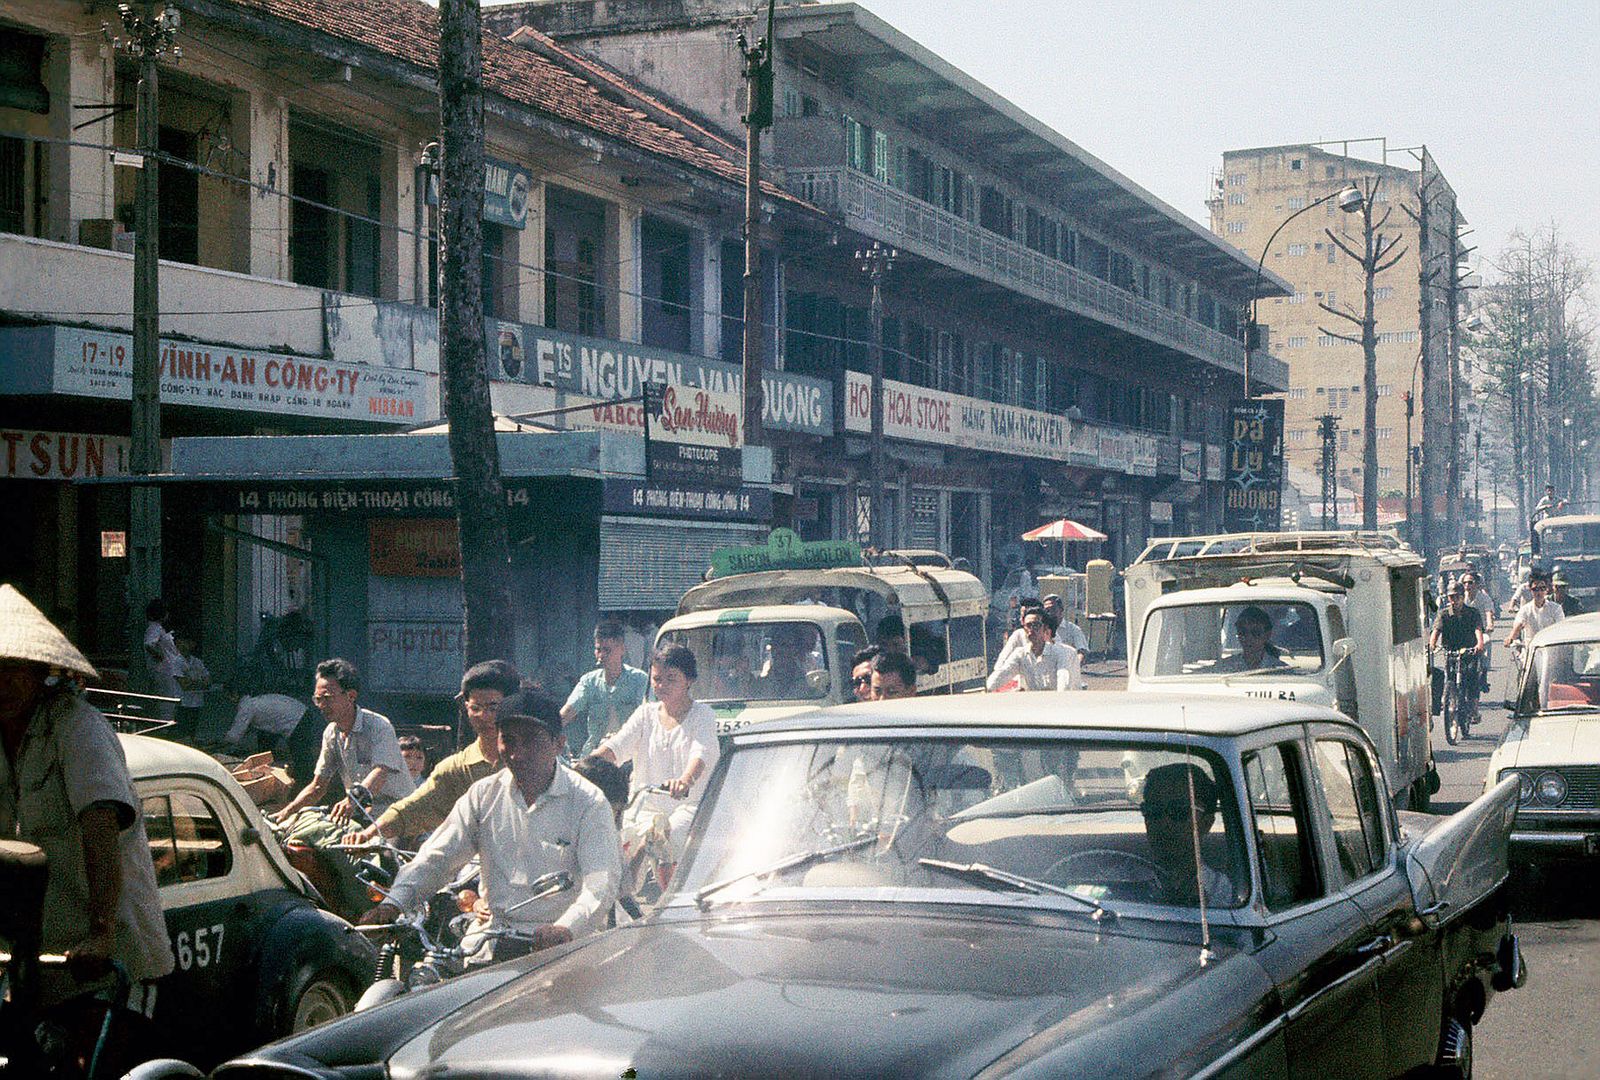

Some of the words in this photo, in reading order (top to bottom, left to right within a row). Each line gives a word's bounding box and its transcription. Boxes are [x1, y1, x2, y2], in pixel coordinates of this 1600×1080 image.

[917, 395, 950, 433] STORE
[239, 490, 260, 508] 14
[507, 488, 528, 507] 14
[177, 924, 224, 971] 657
